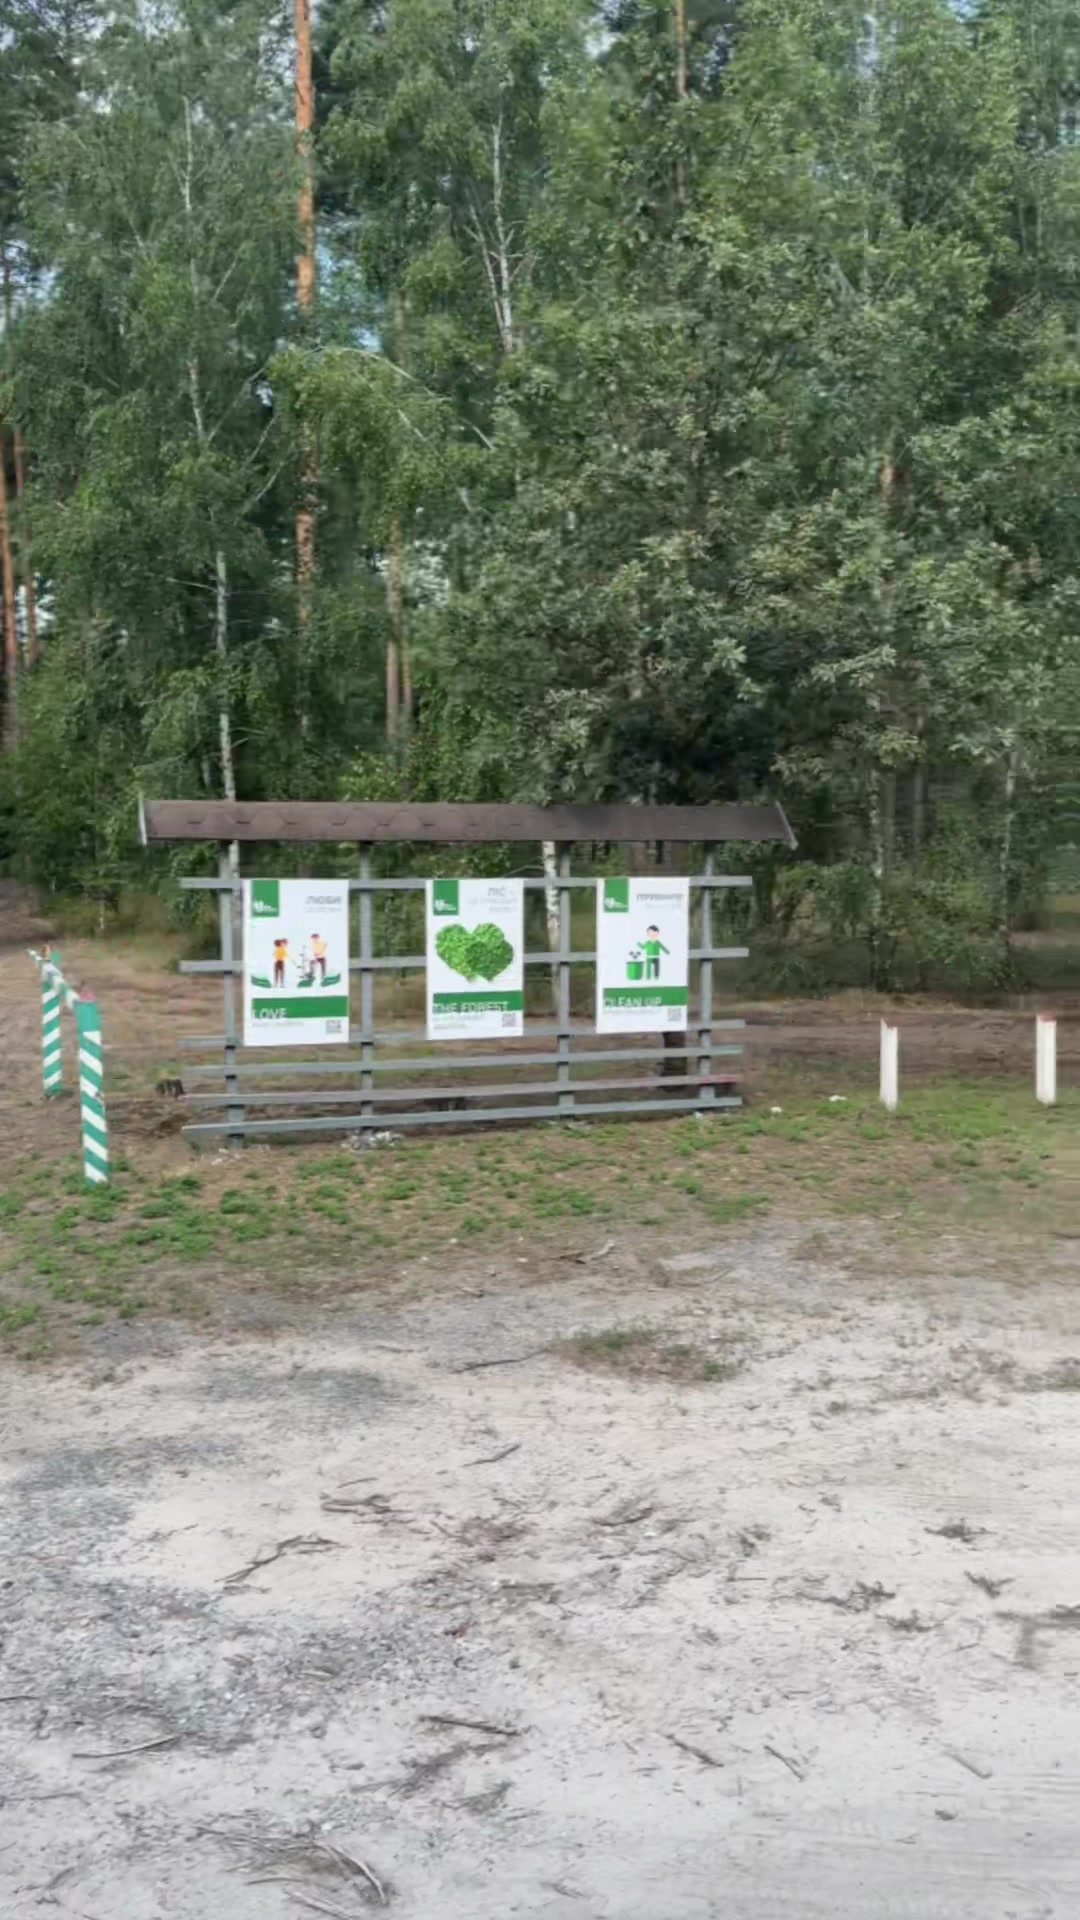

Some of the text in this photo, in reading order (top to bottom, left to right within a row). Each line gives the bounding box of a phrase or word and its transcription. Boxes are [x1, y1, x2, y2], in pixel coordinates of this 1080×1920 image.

[461, 1001, 509, 1013] FOREST
[604, 997, 643, 1008] CLEAN
[252, 1007, 287, 1019] LOVE
